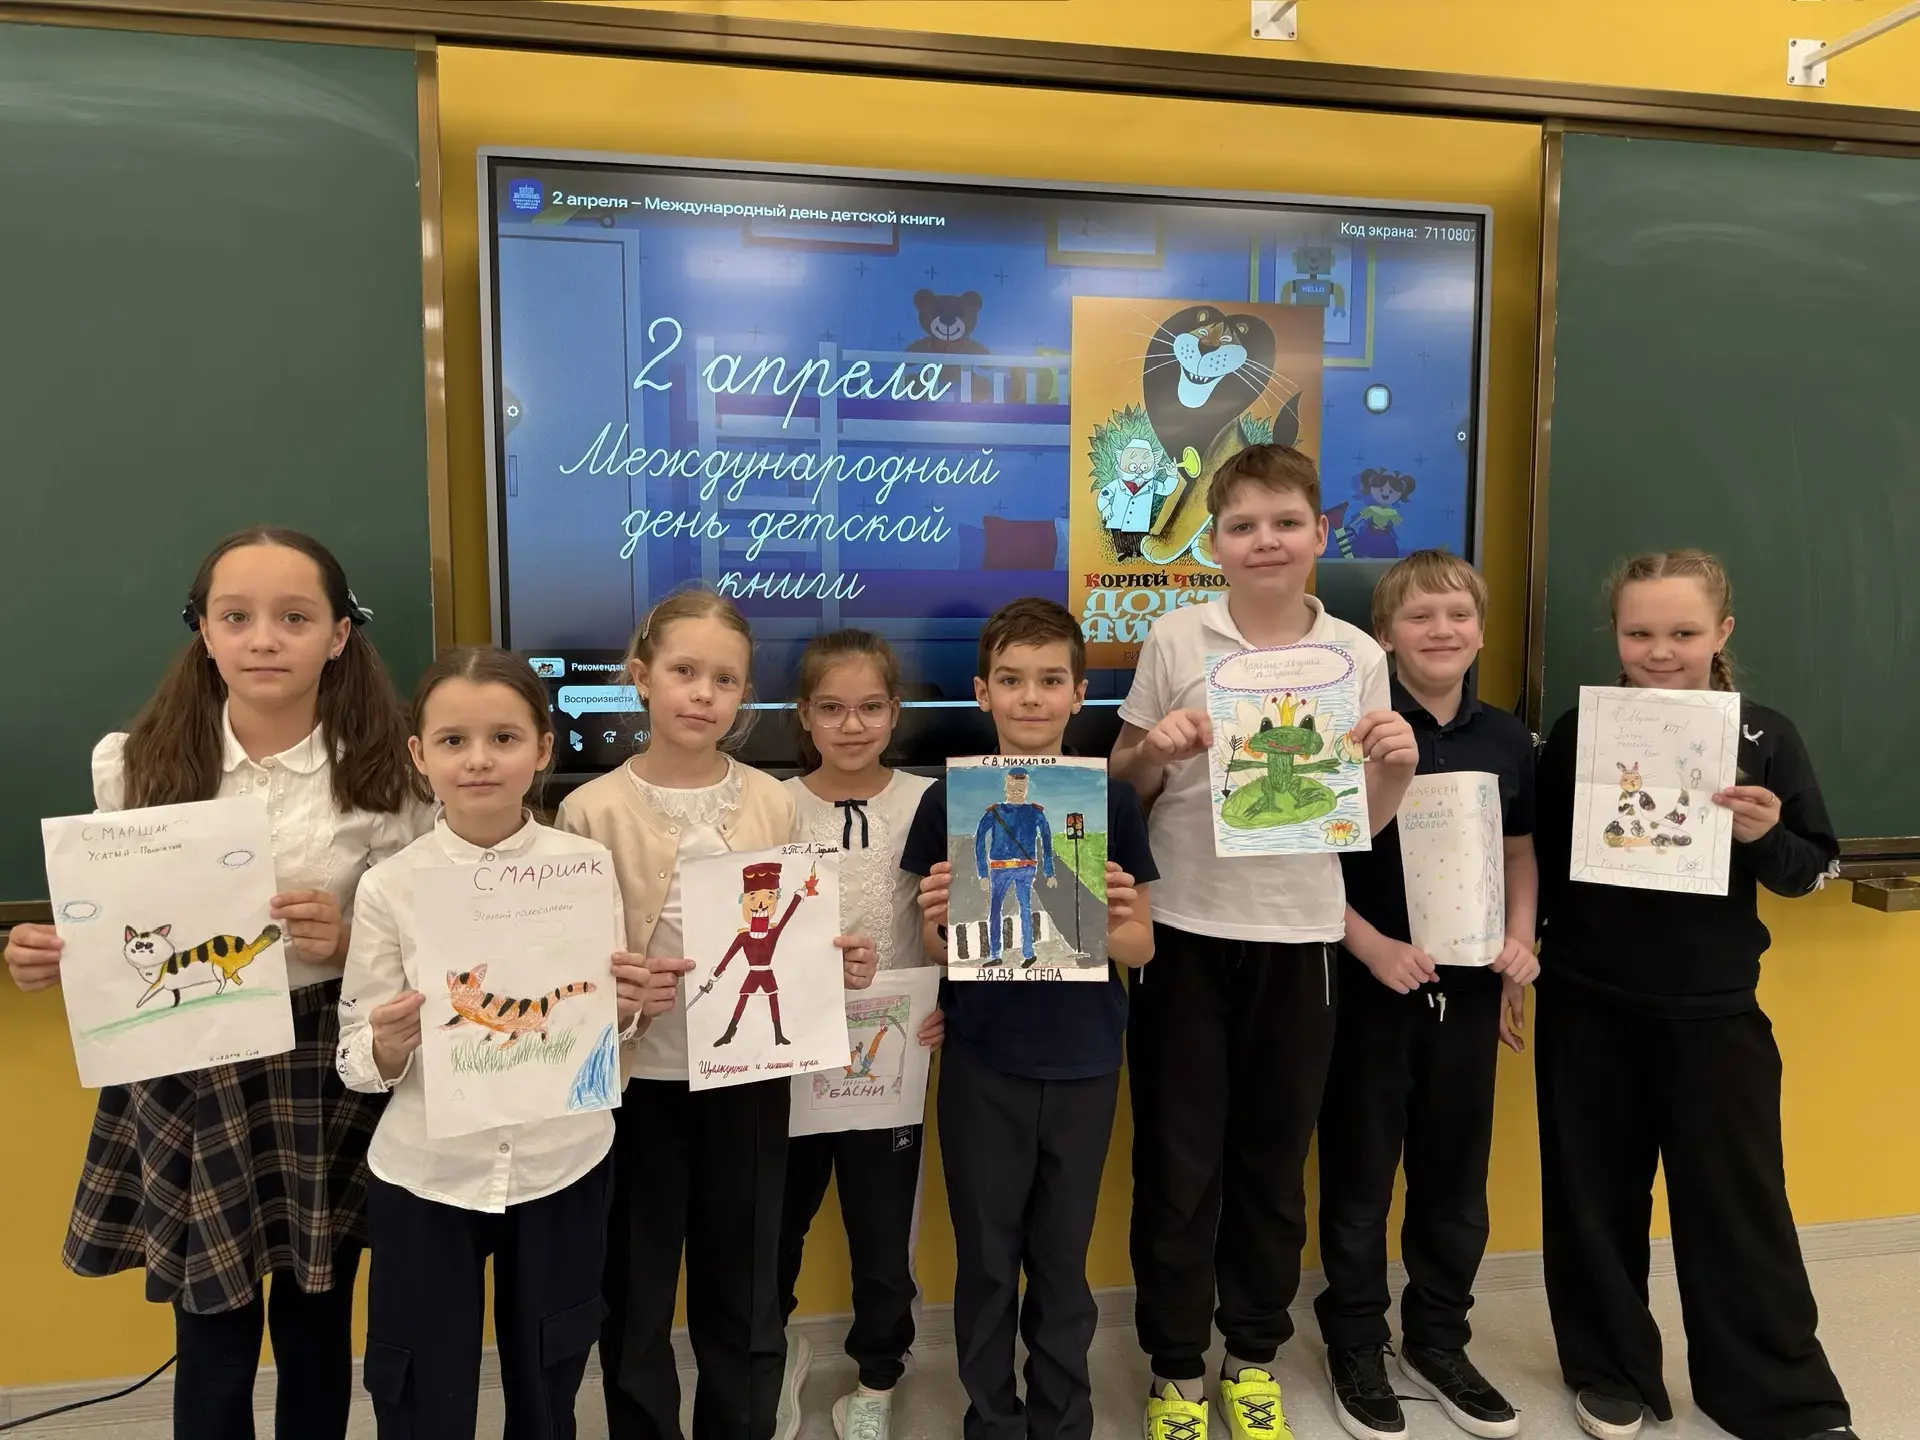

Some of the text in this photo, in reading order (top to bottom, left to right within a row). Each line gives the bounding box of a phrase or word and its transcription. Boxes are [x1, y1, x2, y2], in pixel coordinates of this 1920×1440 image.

[552, 191, 563, 205] 2
[566, 195, 628, 210] апреля
[644, 196, 787, 218] Международный
[789, 206, 829, 220] день
[831, 210, 898, 225] детской
[900, 213, 945, 227] книги
[1340, 222, 1366, 238] Код
[1368, 226, 1418, 239] экрана:
[1302, 285, 1325, 293] HELLO
[632, 317, 952, 429] 2 апреля
[559, 422, 1001, 505] Международный
[619, 506, 951, 562] день детской
[716, 568, 866, 601] книги
[1083, 569, 1232, 589] КОРНЕЙ ЧУКО
[564, 694, 634, 705] Воспроизвести
[605, 736, 615, 744] 10
[976, 968, 1014, 982] ДЯДЯ
[829, 1084, 886, 1099] БАСНИ
